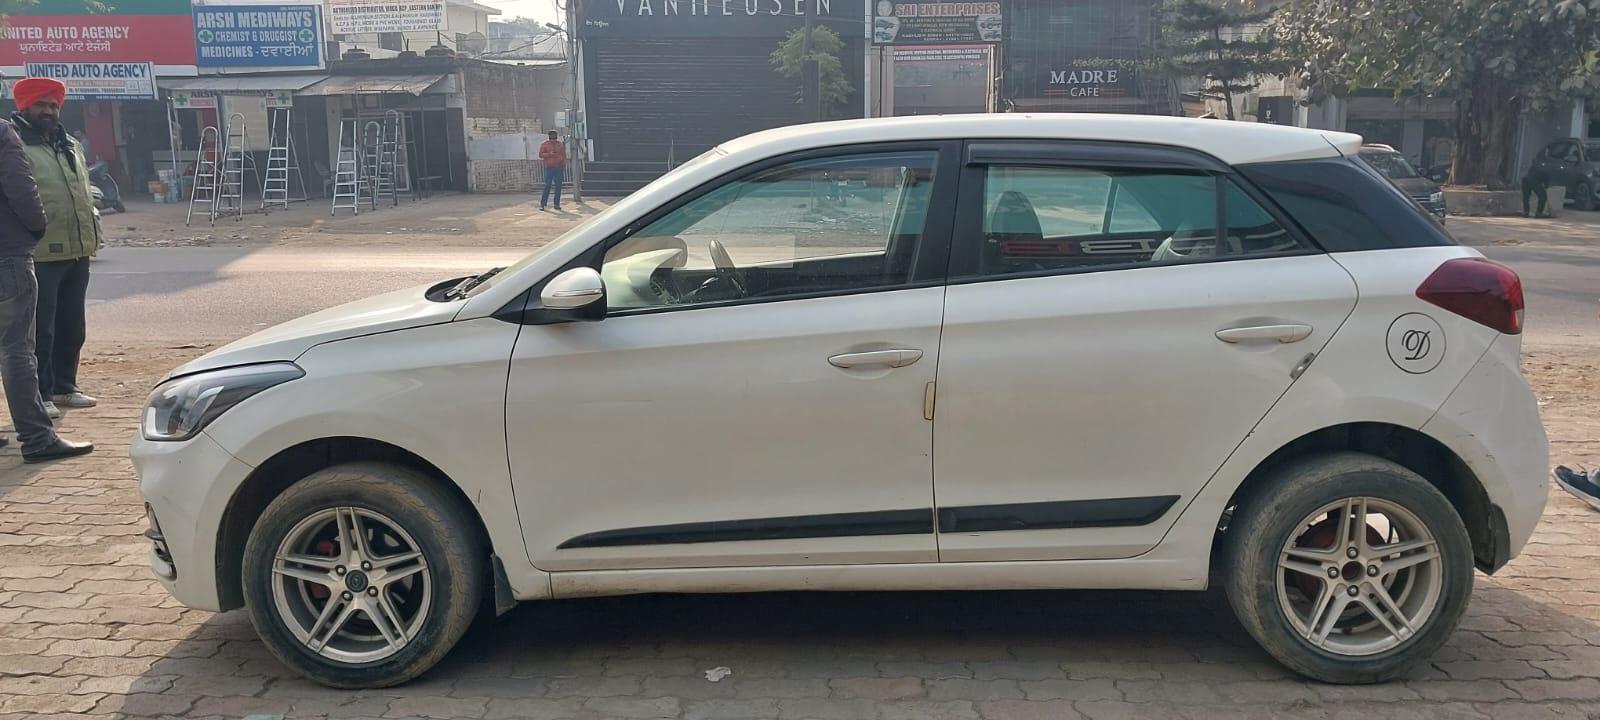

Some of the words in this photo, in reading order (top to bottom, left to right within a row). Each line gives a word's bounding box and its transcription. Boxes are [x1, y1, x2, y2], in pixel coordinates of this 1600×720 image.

[895, 4, 917, 16] SAI
[919, 3, 1000, 16] ENTERPRISES
[198, 12, 235, 28] ARSH
[238, 12, 312, 28] MEDIWAYS
[47, 27, 78, 39] AUTO
[82, 27, 129, 39] AGENCY
[215, 31, 250, 42] CHEMIST
[259, 31, 297, 42] DRUGGIST
[202, 46, 253, 57] MEDICINES
[30, 64, 69, 77] UNITED
[72, 65, 100, 78] AUTO
[102, 64, 146, 78] AGENCY
[1050, 70, 1118, 84] MADRE
